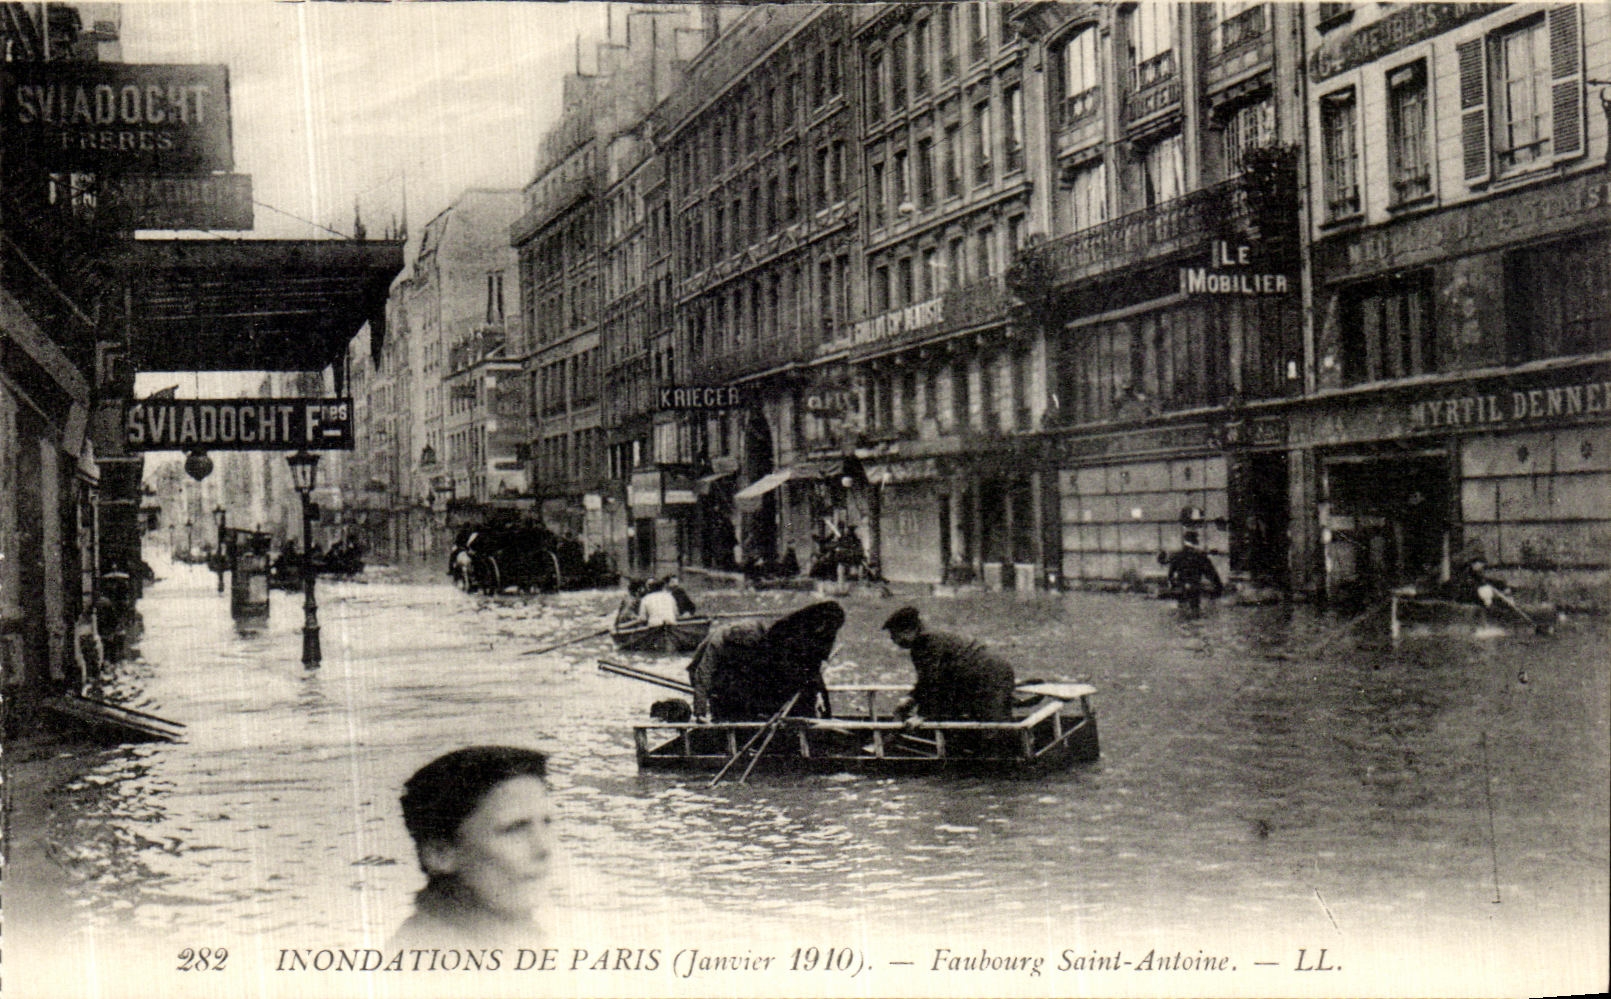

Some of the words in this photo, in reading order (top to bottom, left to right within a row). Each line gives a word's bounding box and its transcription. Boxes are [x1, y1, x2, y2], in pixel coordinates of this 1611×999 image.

[16, 83, 210, 125] SVIADOCHT
[1187, 267, 1288, 294] MOBILIER
[660, 386, 740, 409] KRIEGER
[1410, 394, 1503, 427] MYRTIL
[127, 404, 294, 443] SVIADOCHT
